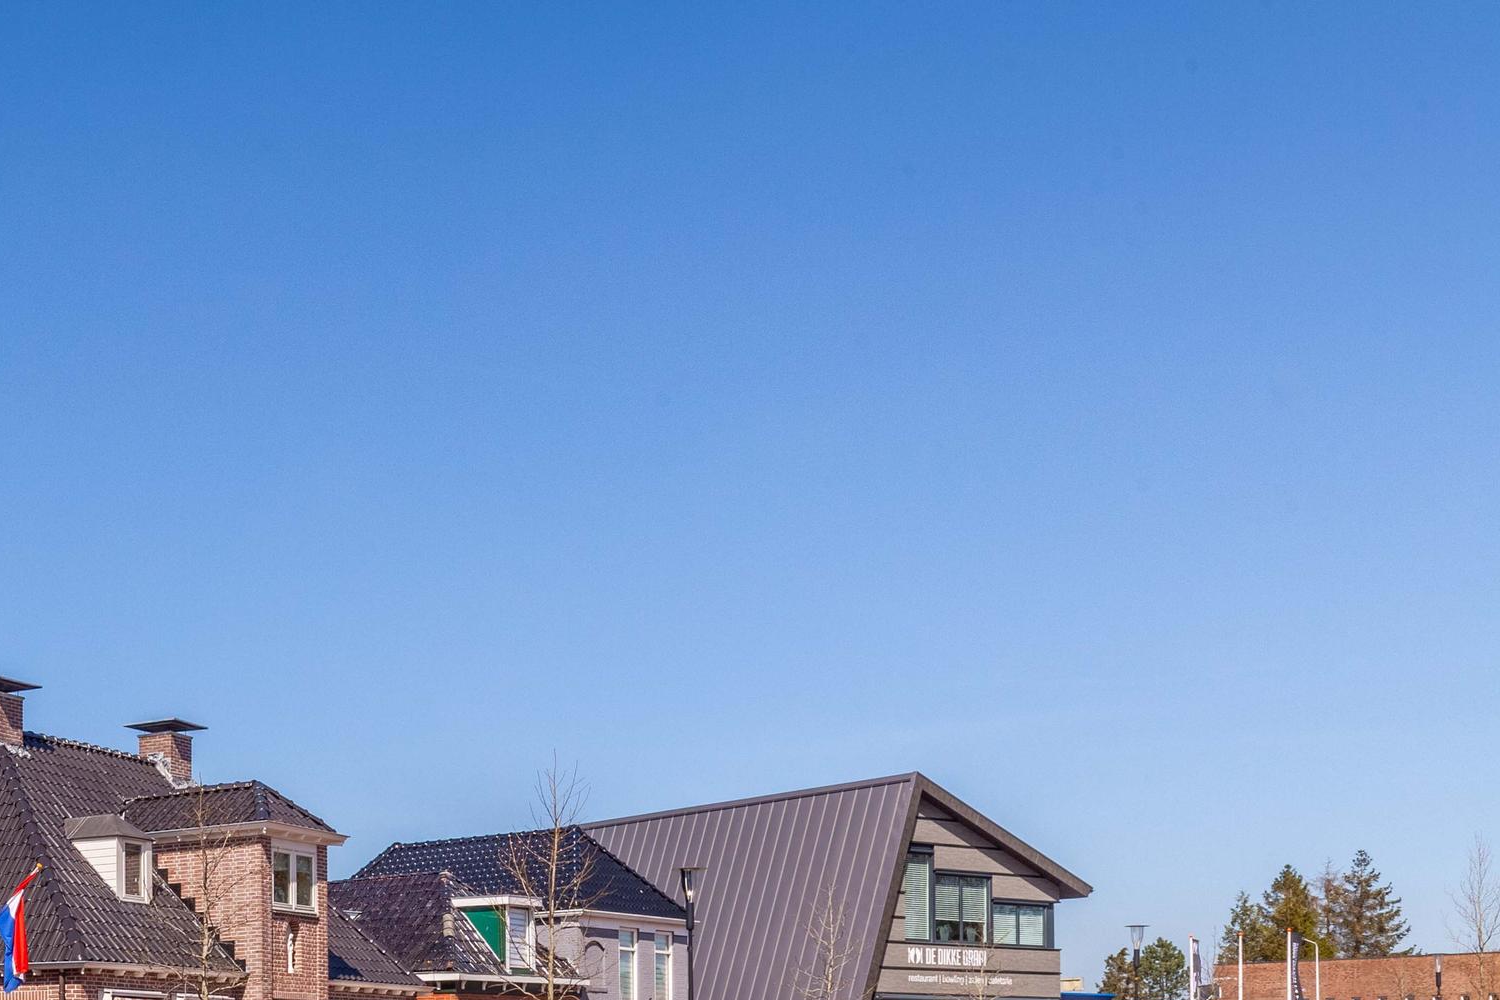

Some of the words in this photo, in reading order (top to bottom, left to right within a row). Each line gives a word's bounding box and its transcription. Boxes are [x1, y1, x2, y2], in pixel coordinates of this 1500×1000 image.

[925, 948, 937, 965] DE
[938, 949, 961, 966] DIKKE
[908, 974, 938, 983] restaurant
